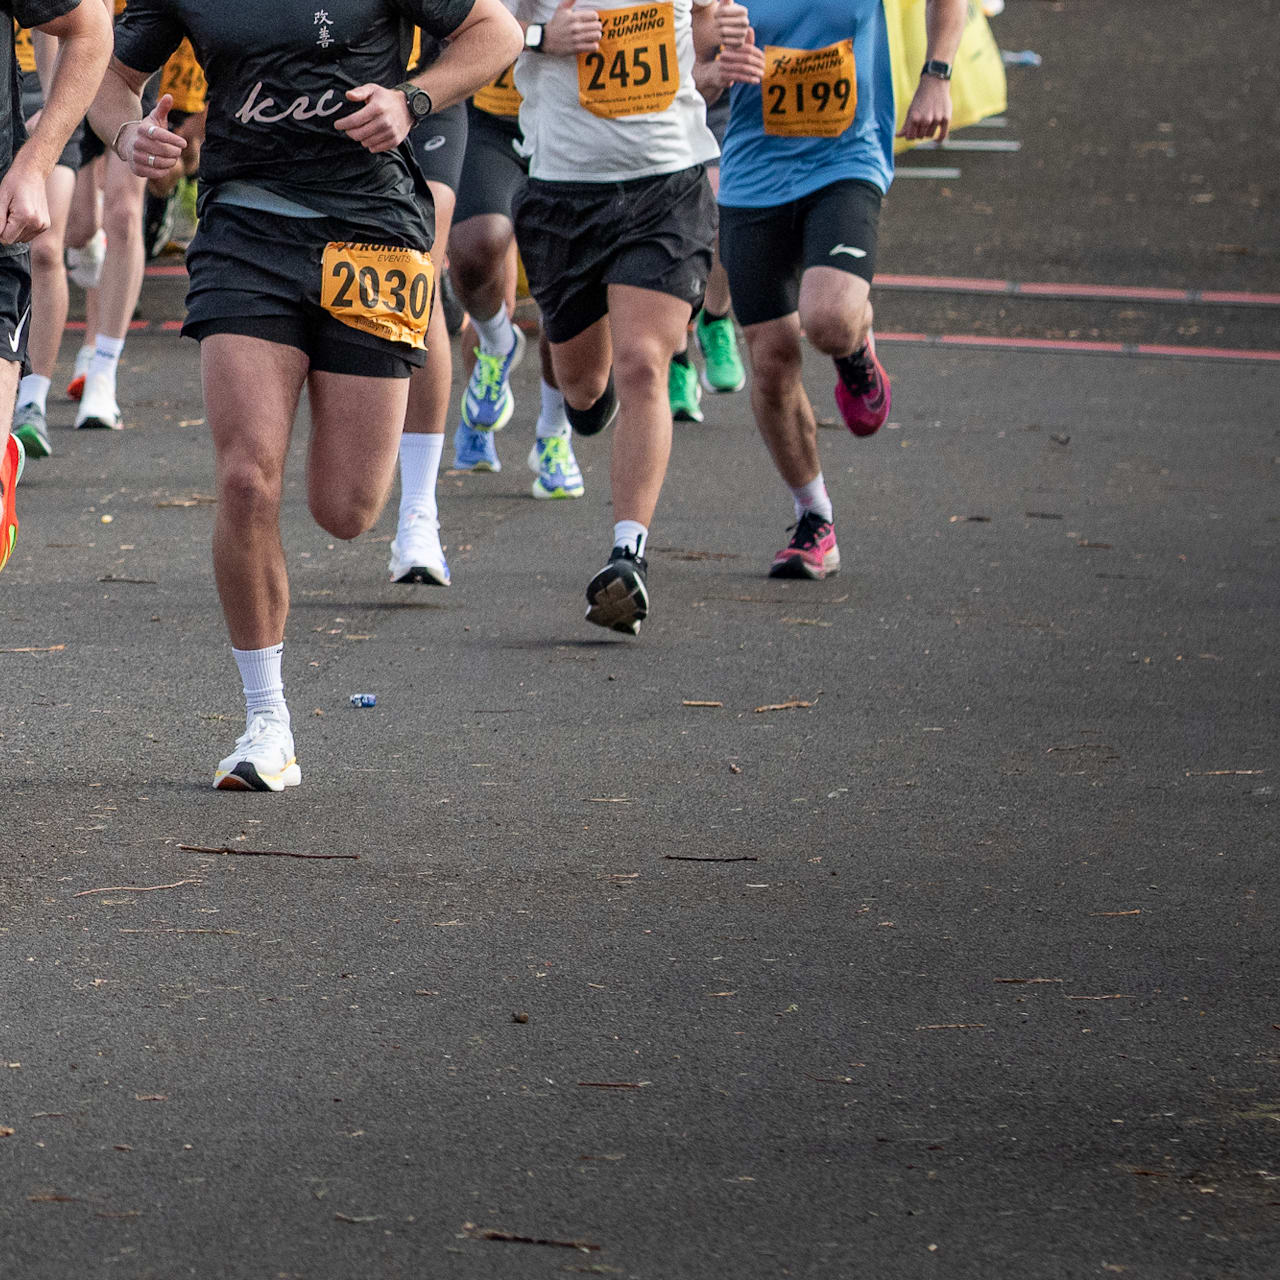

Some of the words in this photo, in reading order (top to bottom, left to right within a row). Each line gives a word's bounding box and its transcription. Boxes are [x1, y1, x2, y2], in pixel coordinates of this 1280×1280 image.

[313, 9, 335, 48] 改善
[607, 17, 665, 40] RUNNING
[613, 14, 629, 27] UP
[631, 7, 658, 21] AND
[585, 43, 669, 91] 2451
[768, 77, 851, 115] 2199
[377, 254, 411, 263] EVENTS
[331, 261, 428, 319] 2030
